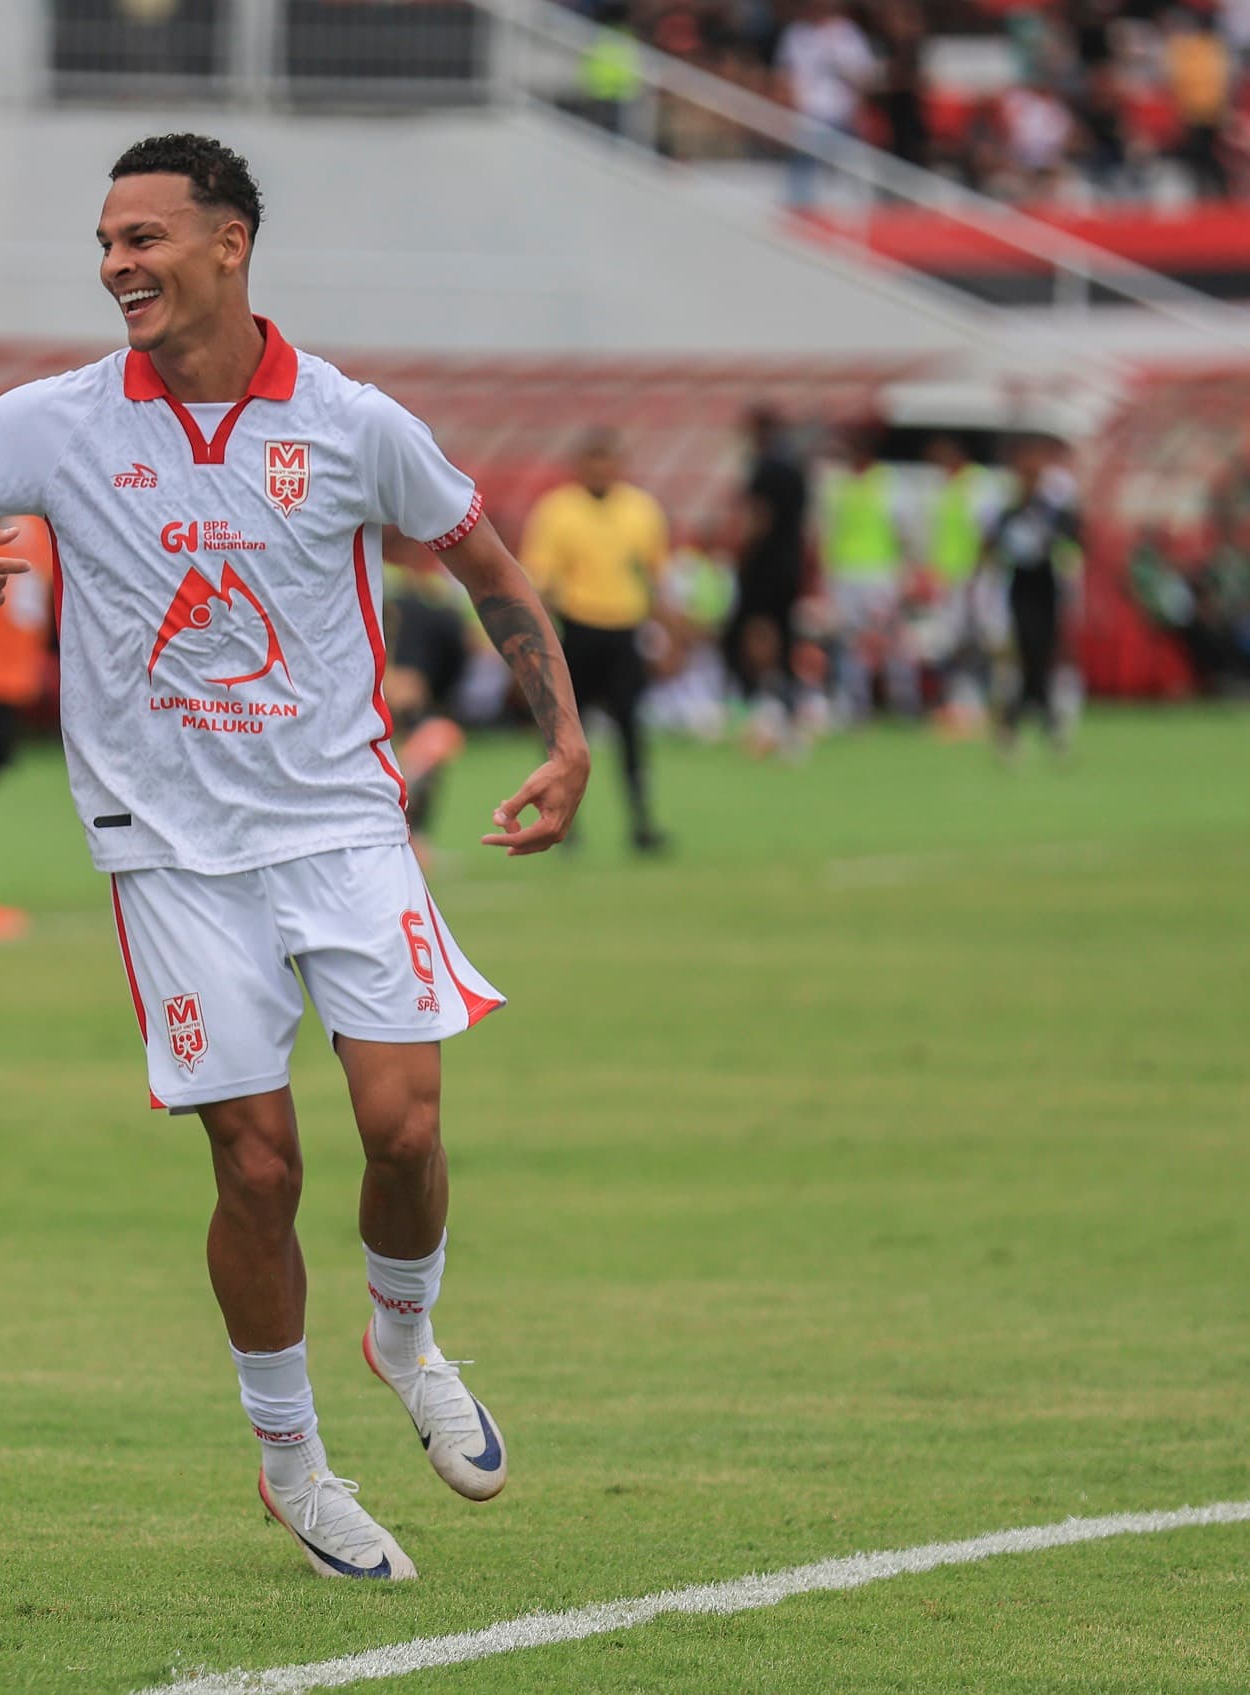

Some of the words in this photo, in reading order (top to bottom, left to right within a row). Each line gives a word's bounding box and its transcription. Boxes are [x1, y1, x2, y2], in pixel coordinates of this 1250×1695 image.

[113, 476, 158, 489] SPECS
[203, 520, 229, 531] BPR
[203, 530, 242, 541] Global
[203, 540, 267, 551] Nusantara
[149, 696, 244, 715] LUMBUNG
[247, 702, 298, 717] IKAN
[181, 714, 264, 735] MALUKU
[399, 909, 434, 985] 6
